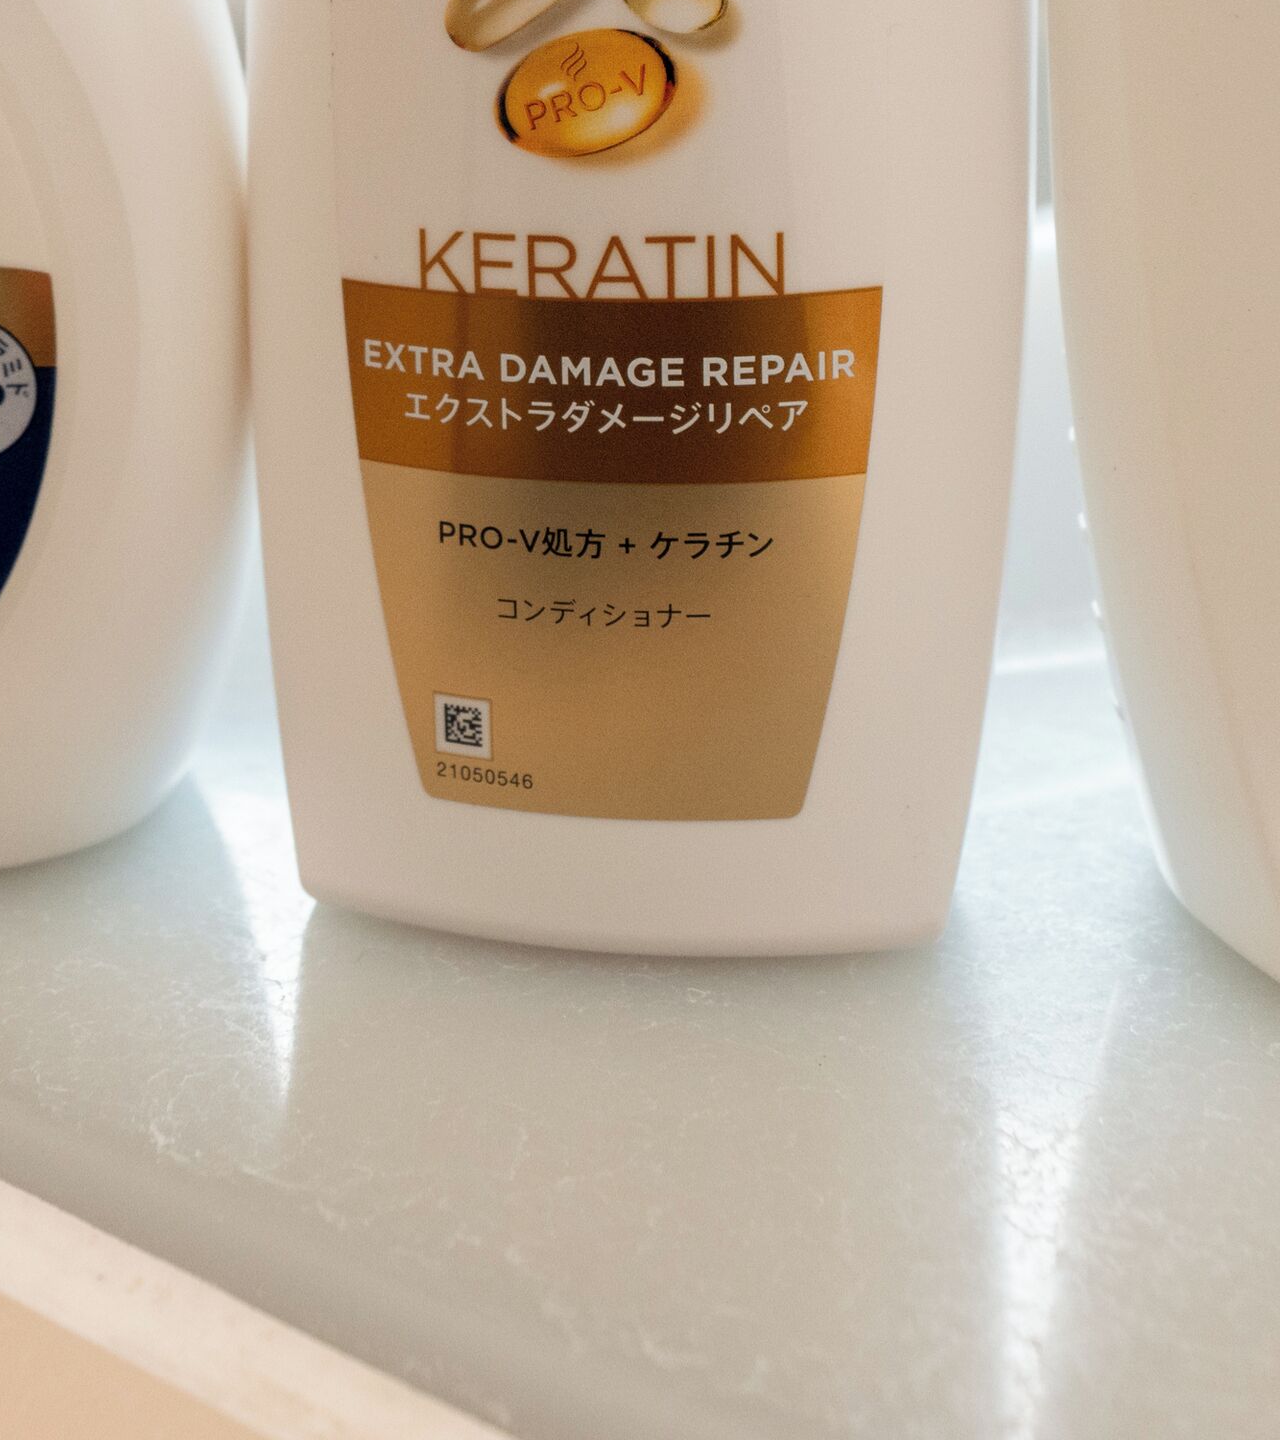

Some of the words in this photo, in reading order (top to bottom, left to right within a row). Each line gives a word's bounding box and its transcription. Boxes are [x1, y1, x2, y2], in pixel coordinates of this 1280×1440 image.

[524, 63, 649, 132] PRO-V
[419, 227, 785, 300] KERATIN
[363, 338, 484, 382] EXTRA
[499, 353, 685, 388] DAMAGE
[701, 348, 856, 387] REPAIR
[403, 392, 809, 436] エクストラダメージリペア
[438, 520, 606, 560] PRO-V処方
[649, 529, 774, 560] ケラチン
[496, 597, 712, 629] コンディショナー
[436, 762, 534, 790] 21050546
